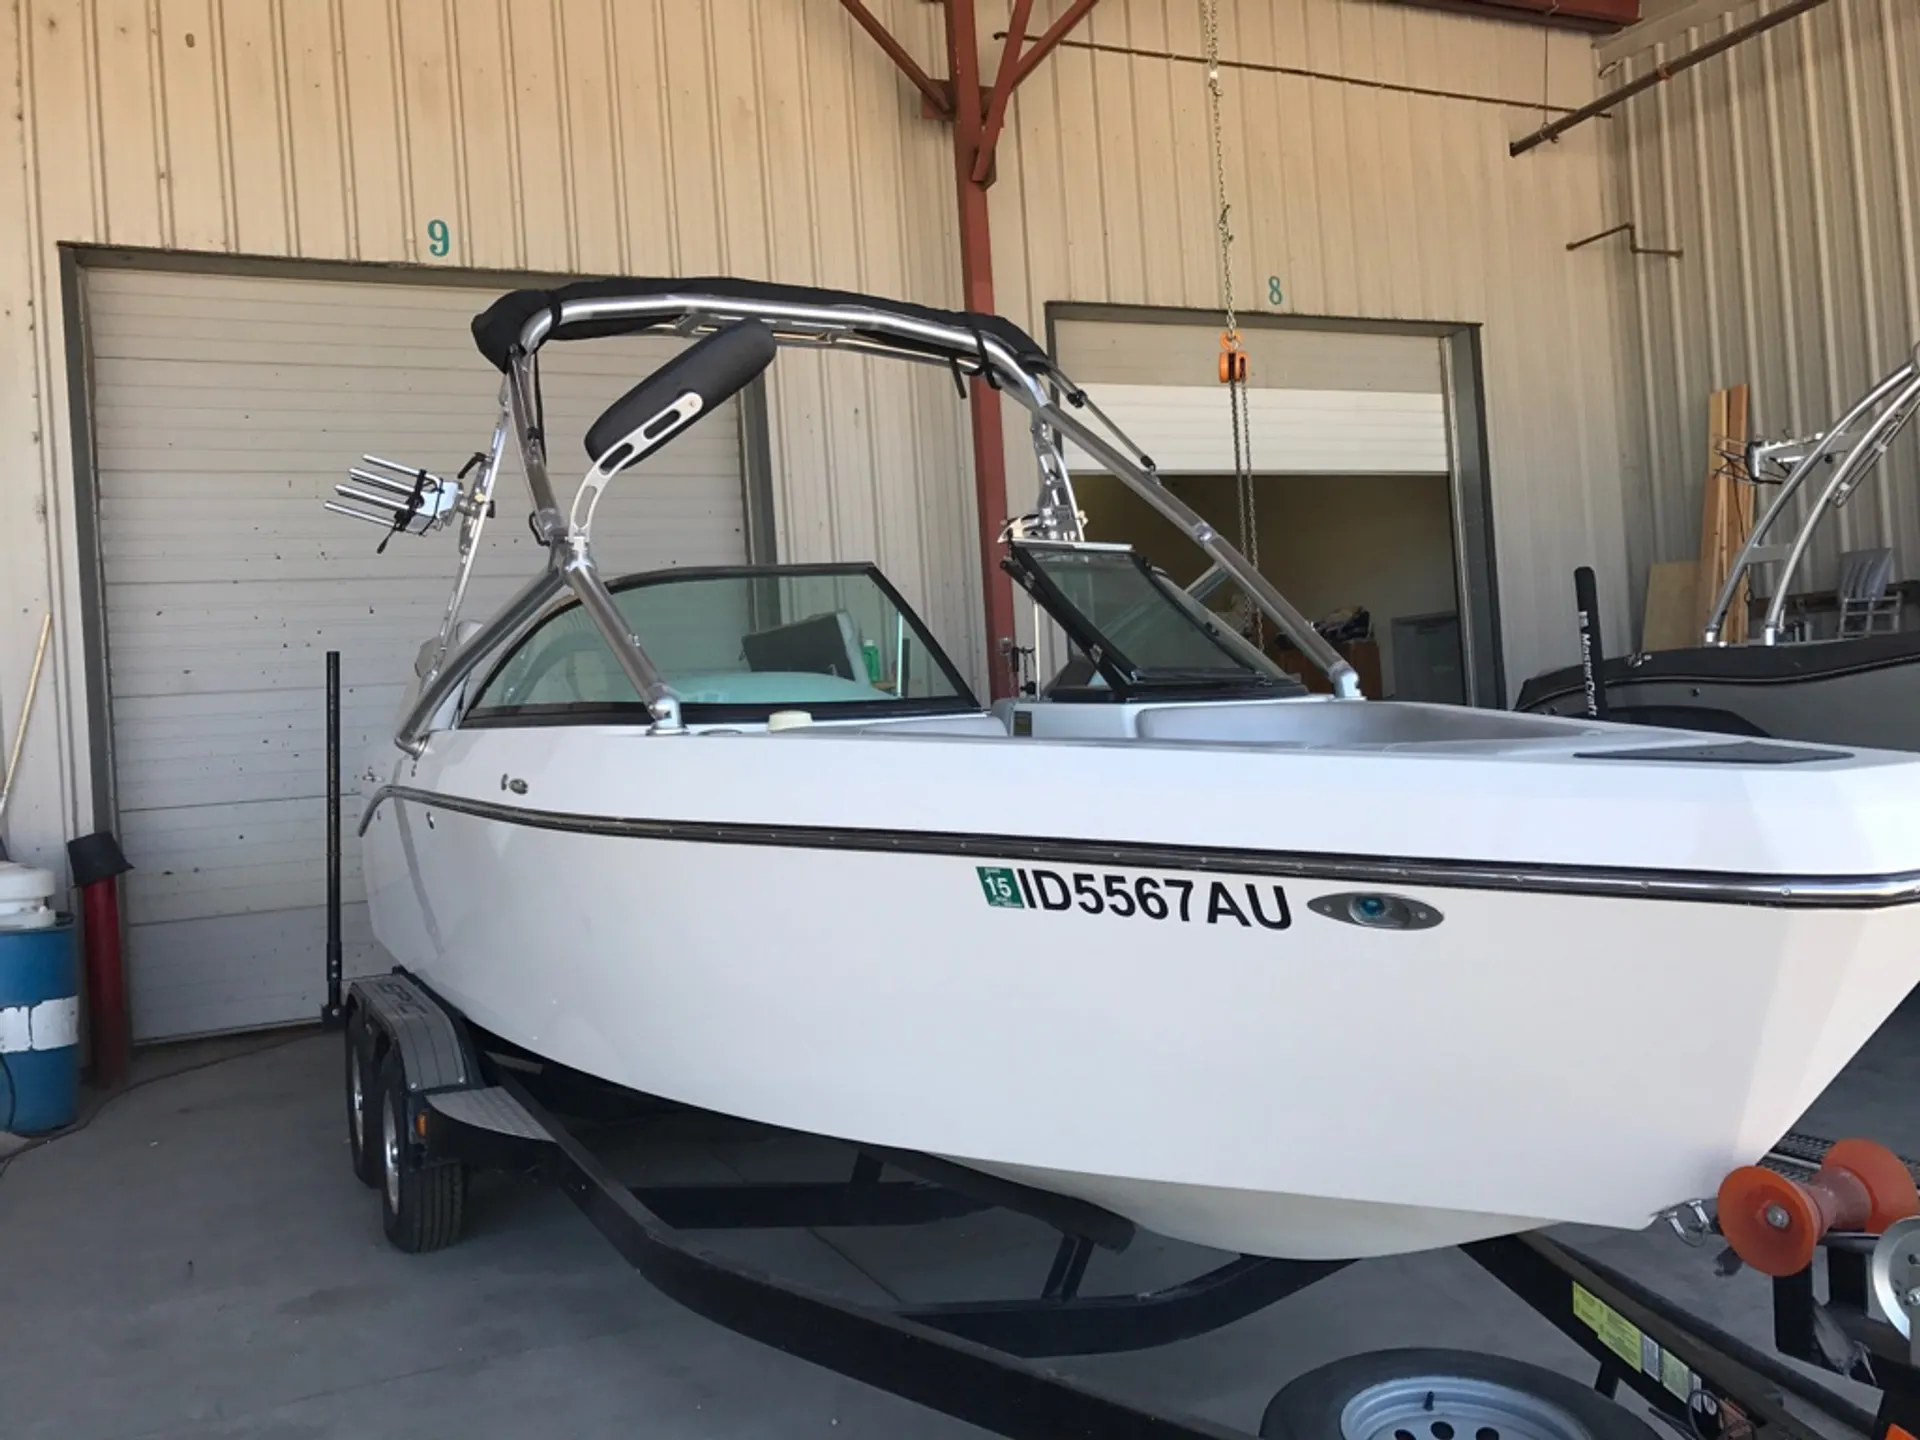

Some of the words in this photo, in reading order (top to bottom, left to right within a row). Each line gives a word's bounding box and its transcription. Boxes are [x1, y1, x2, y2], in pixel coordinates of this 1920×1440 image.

[427, 219, 449, 257] 9
[1268, 276, 1283, 305] 8
[1580, 633, 1598, 717] MasterCraft
[985, 876, 1012, 898] 15
